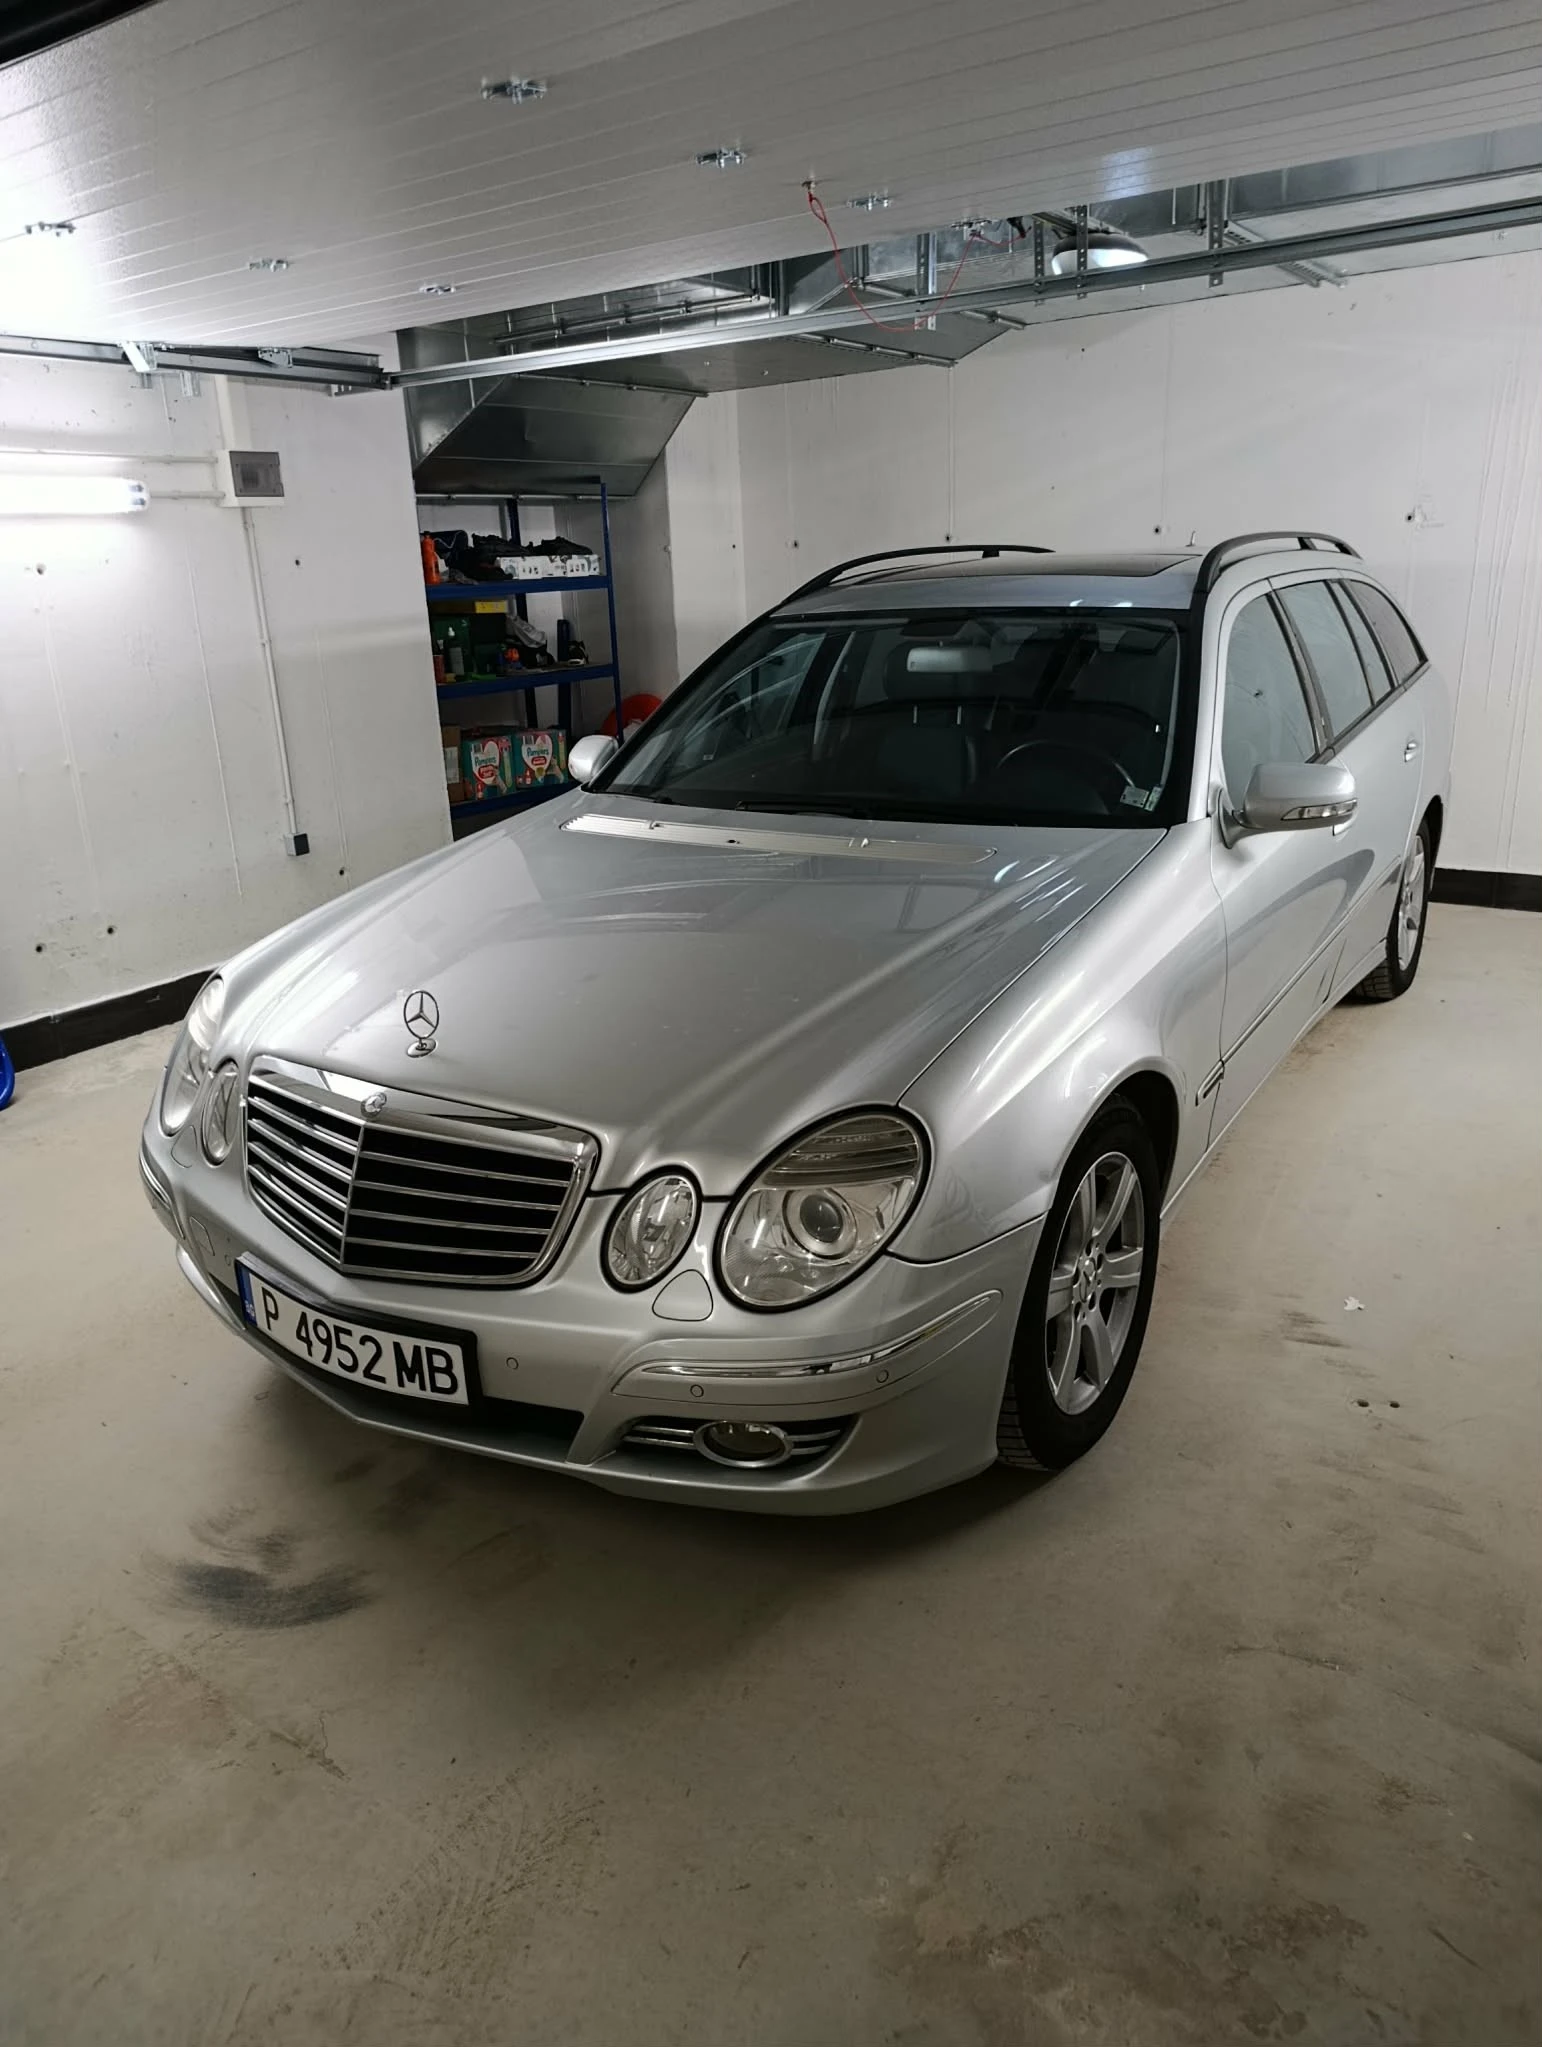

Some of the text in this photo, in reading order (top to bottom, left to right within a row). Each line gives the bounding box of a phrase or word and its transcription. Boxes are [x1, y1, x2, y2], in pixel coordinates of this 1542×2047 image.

[527, 747, 549, 756] Pampers
[475, 756, 496, 765] Pampers
[261, 1286, 458, 1395] P 4952 MB
